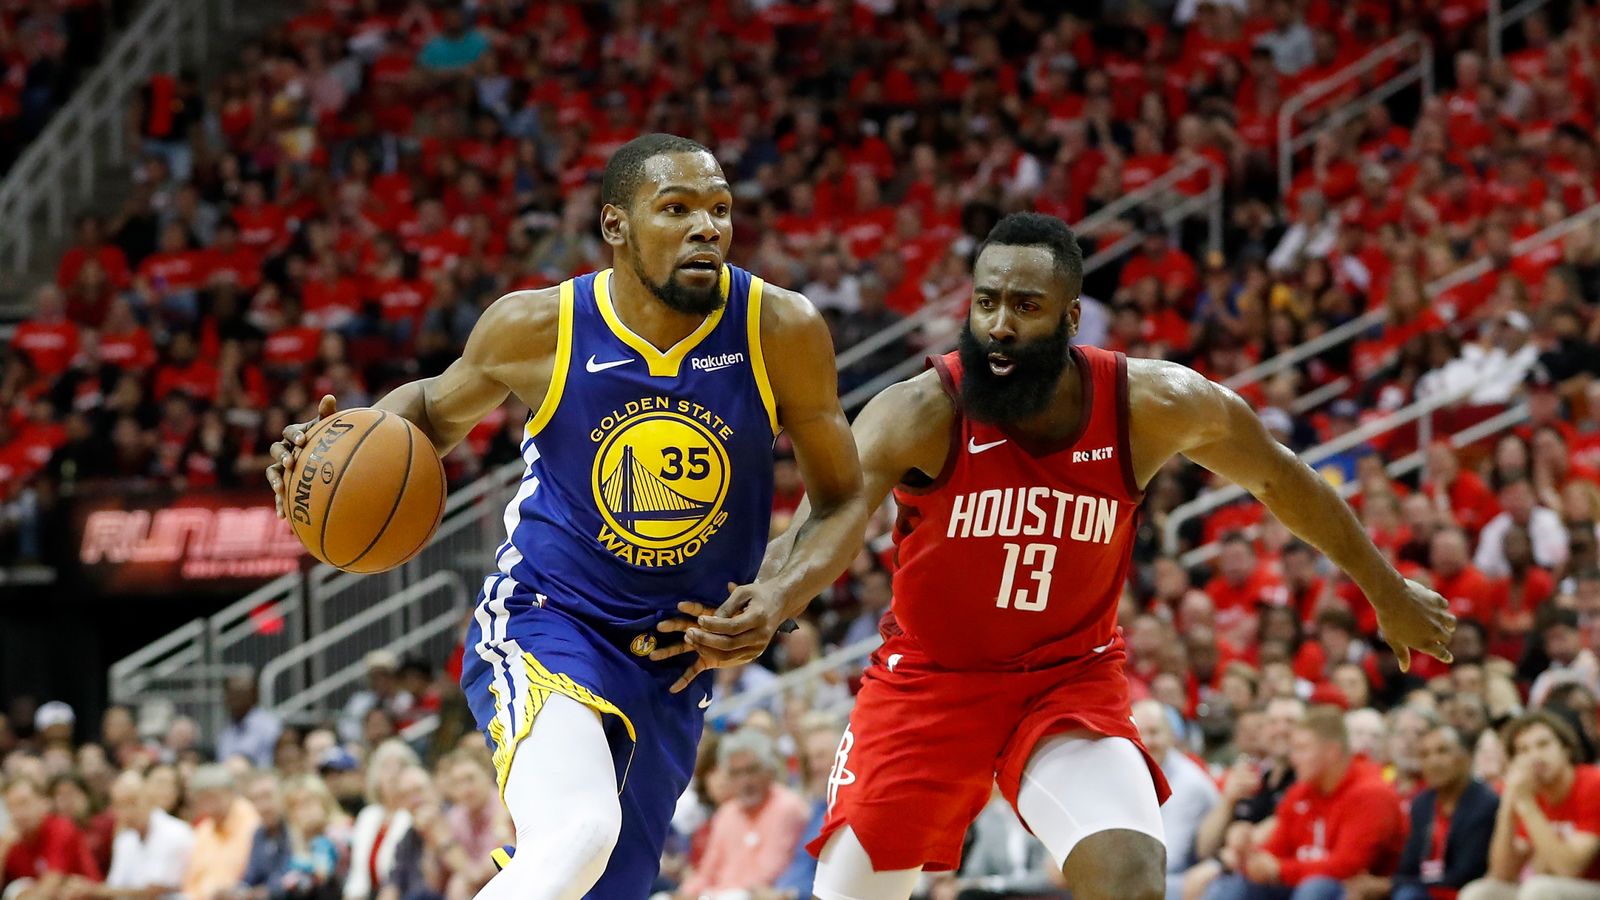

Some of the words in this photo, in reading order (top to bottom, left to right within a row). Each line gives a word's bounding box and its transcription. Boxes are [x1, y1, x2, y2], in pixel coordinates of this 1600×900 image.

[691, 352, 744, 370] Rakuten
[590, 396, 669, 443] GOLDEN
[677, 400, 734, 441] STATE
[292, 419, 354, 526] SPALDING
[659, 446, 711, 481] 35
[596, 510, 729, 568] WARRIORS
[946, 486, 1118, 545] HOUSTON
[995, 542, 1058, 612] 13
